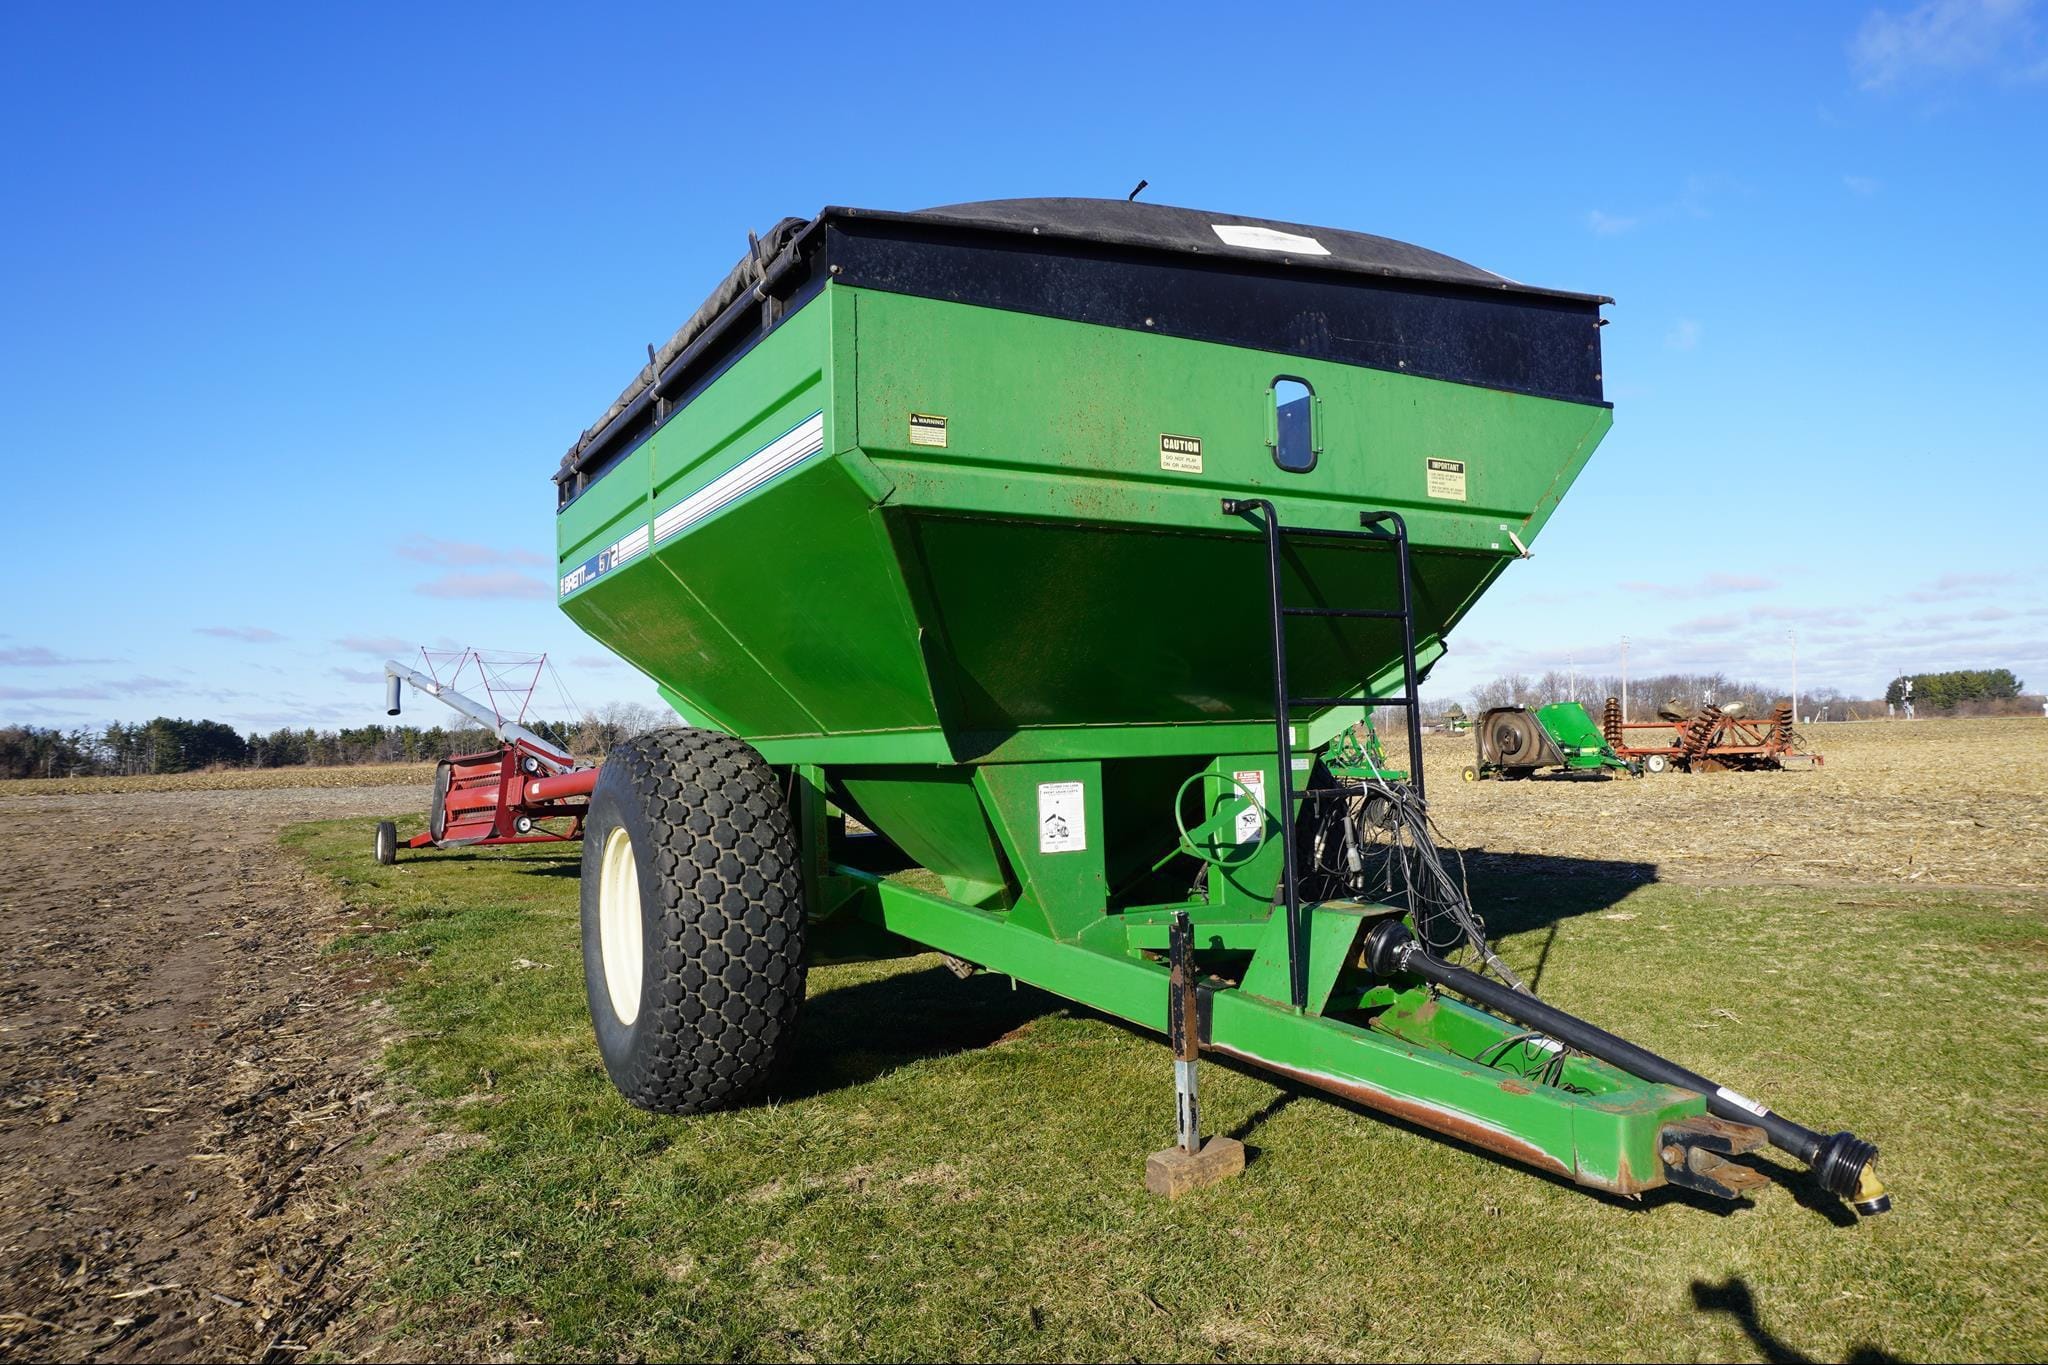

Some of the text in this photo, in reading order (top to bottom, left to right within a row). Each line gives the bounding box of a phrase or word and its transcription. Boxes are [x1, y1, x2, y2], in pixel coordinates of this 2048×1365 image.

[917, 417, 945, 426] WARNING
[1163, 438, 1199, 453] CAUTION
[1431, 461, 1460, 472] IMPORTANT
[564, 543, 619, 594] BRENT 672
